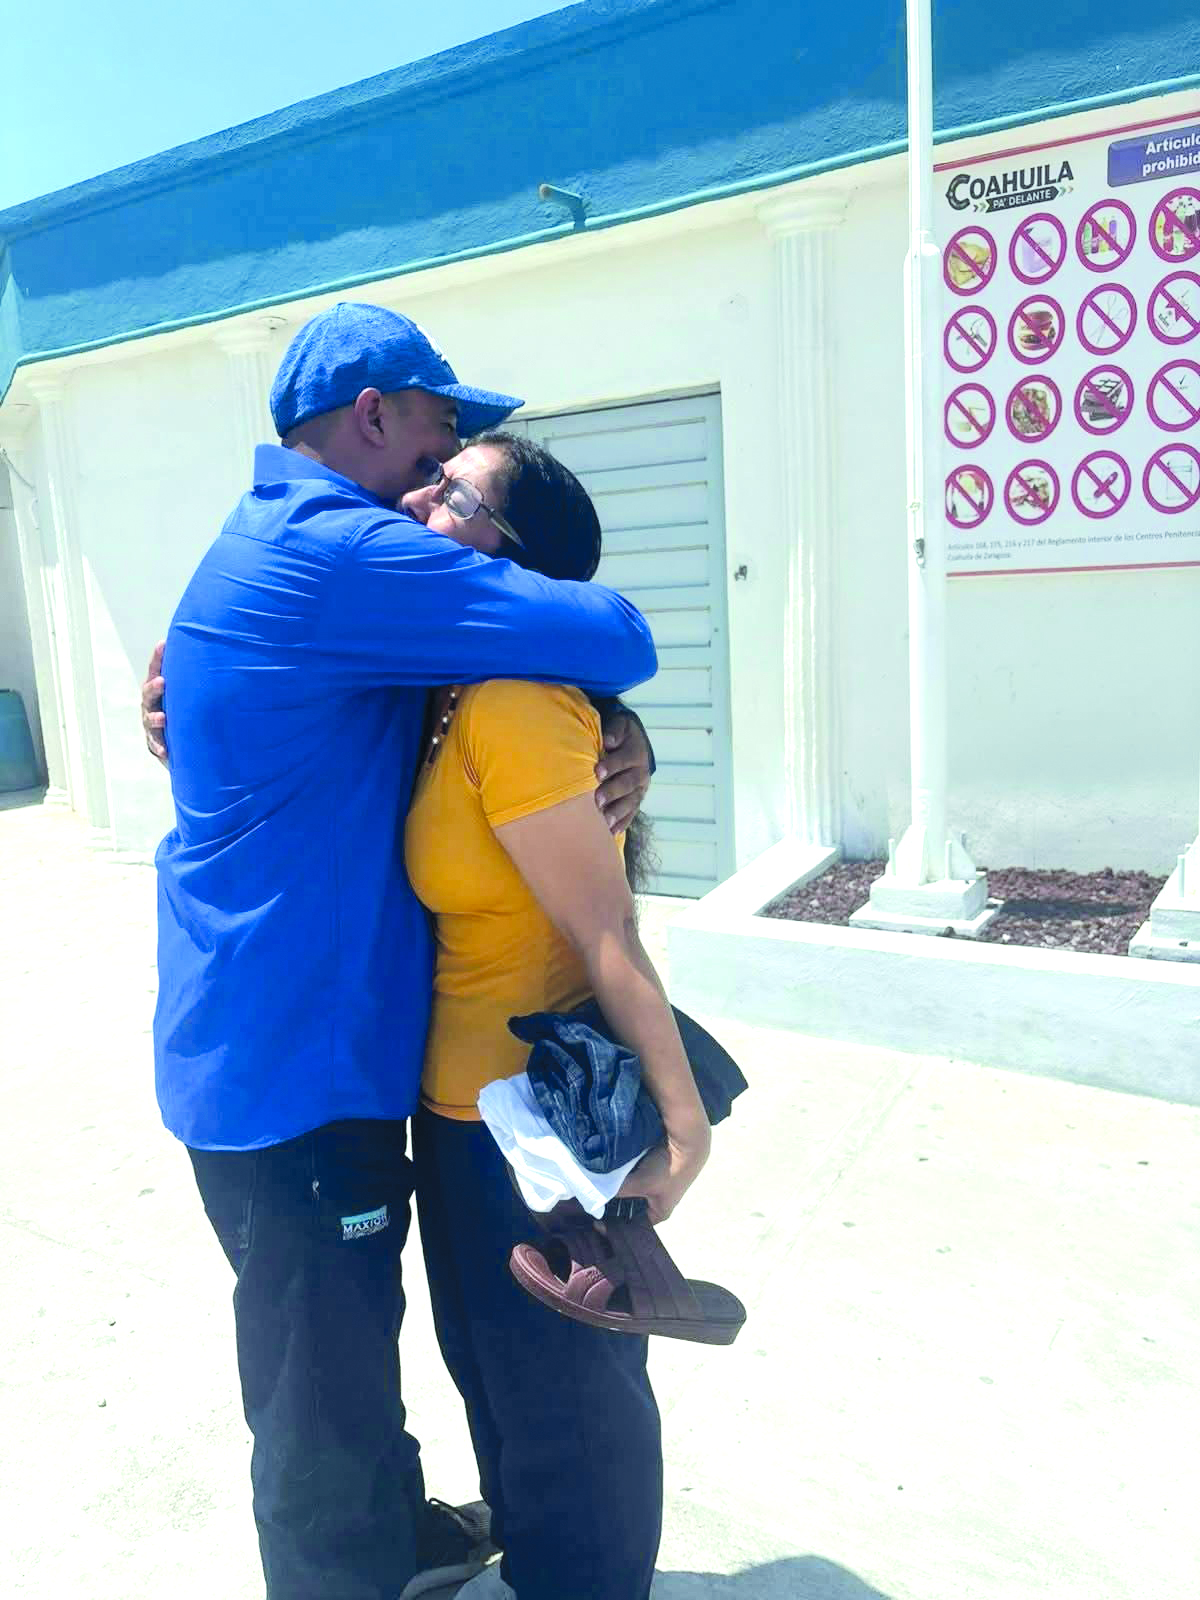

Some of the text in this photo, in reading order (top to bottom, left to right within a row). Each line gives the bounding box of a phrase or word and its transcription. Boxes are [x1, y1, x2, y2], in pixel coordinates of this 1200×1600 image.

[945, 160, 1074, 210] COAHUILA
[1008, 189, 1052, 206] DELANTE
[1135, 531, 1162, 541] Centros
